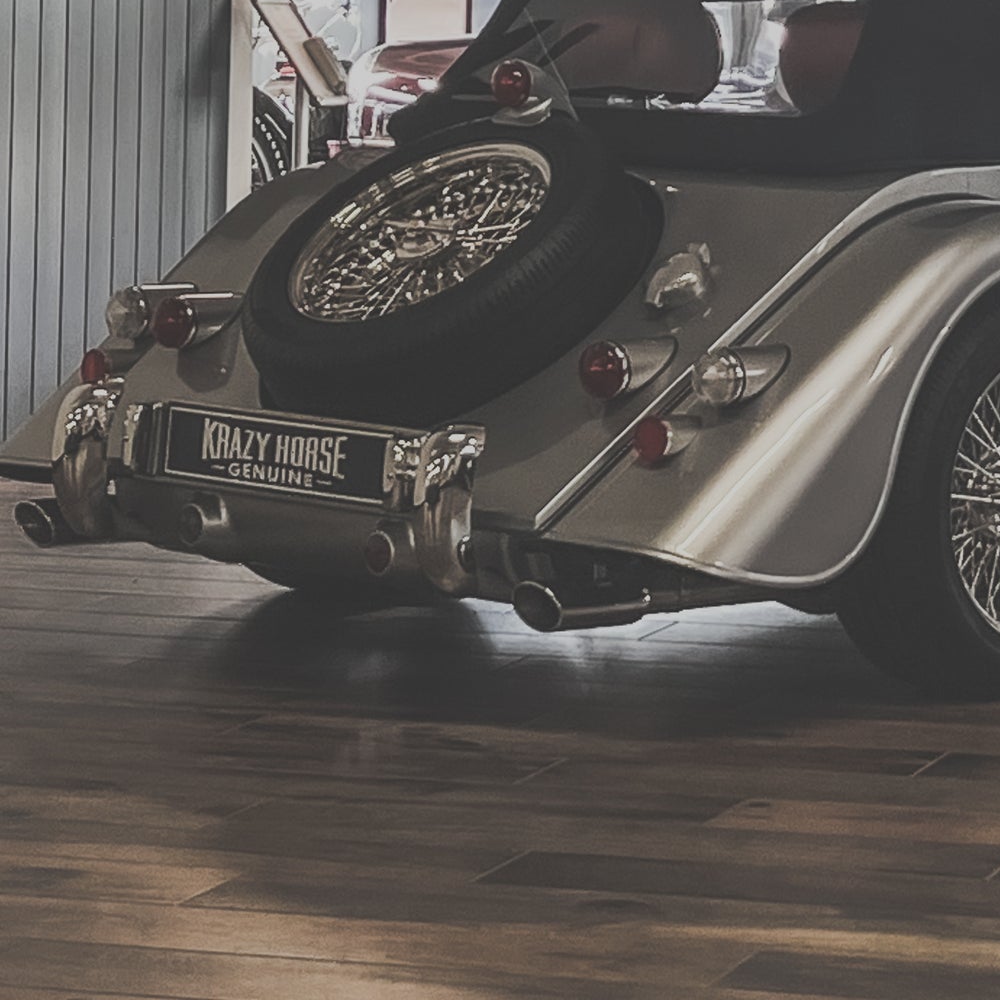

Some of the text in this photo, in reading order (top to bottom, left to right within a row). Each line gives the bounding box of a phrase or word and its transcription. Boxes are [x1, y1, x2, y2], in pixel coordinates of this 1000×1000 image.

[202, 417, 349, 480] KRAZY HORSE
[228, 462, 313, 488] GENUINE
